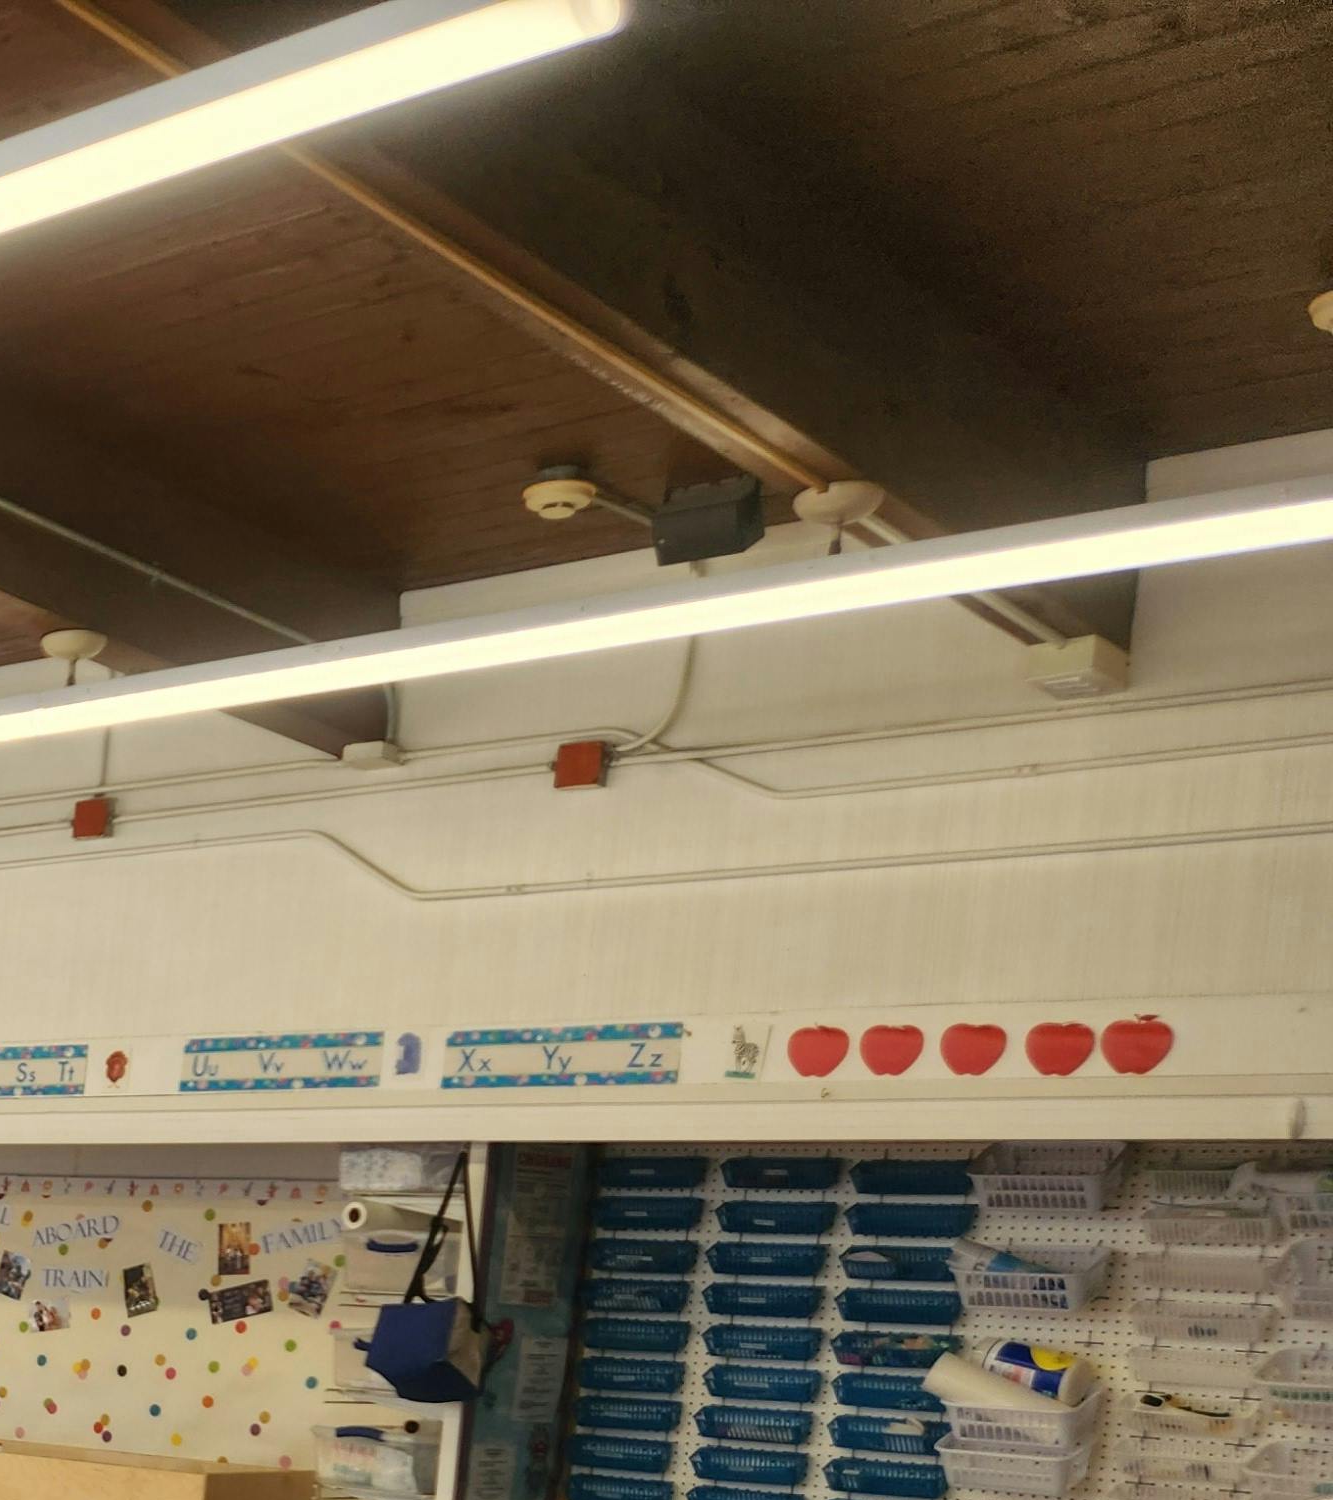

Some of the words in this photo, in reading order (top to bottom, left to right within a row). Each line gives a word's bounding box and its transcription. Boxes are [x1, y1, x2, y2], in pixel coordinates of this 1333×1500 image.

[16, 1062, 36, 1082] Ss
[58, 1060, 75, 1082] Tt
[193, 1055, 219, 1077] Uu
[259, 1052, 284, 1073] Vv
[323, 1050, 368, 1071] Ww
[458, 1048, 492, 1072] Xx
[542, 1045, 573, 1073] Yy
[627, 1042, 663, 1068] Zz
[33, 1215, 120, 1247] ABOARD
[158, 1230, 198, 1262] THE
[261, 1217, 343, 1255] FAMILY
